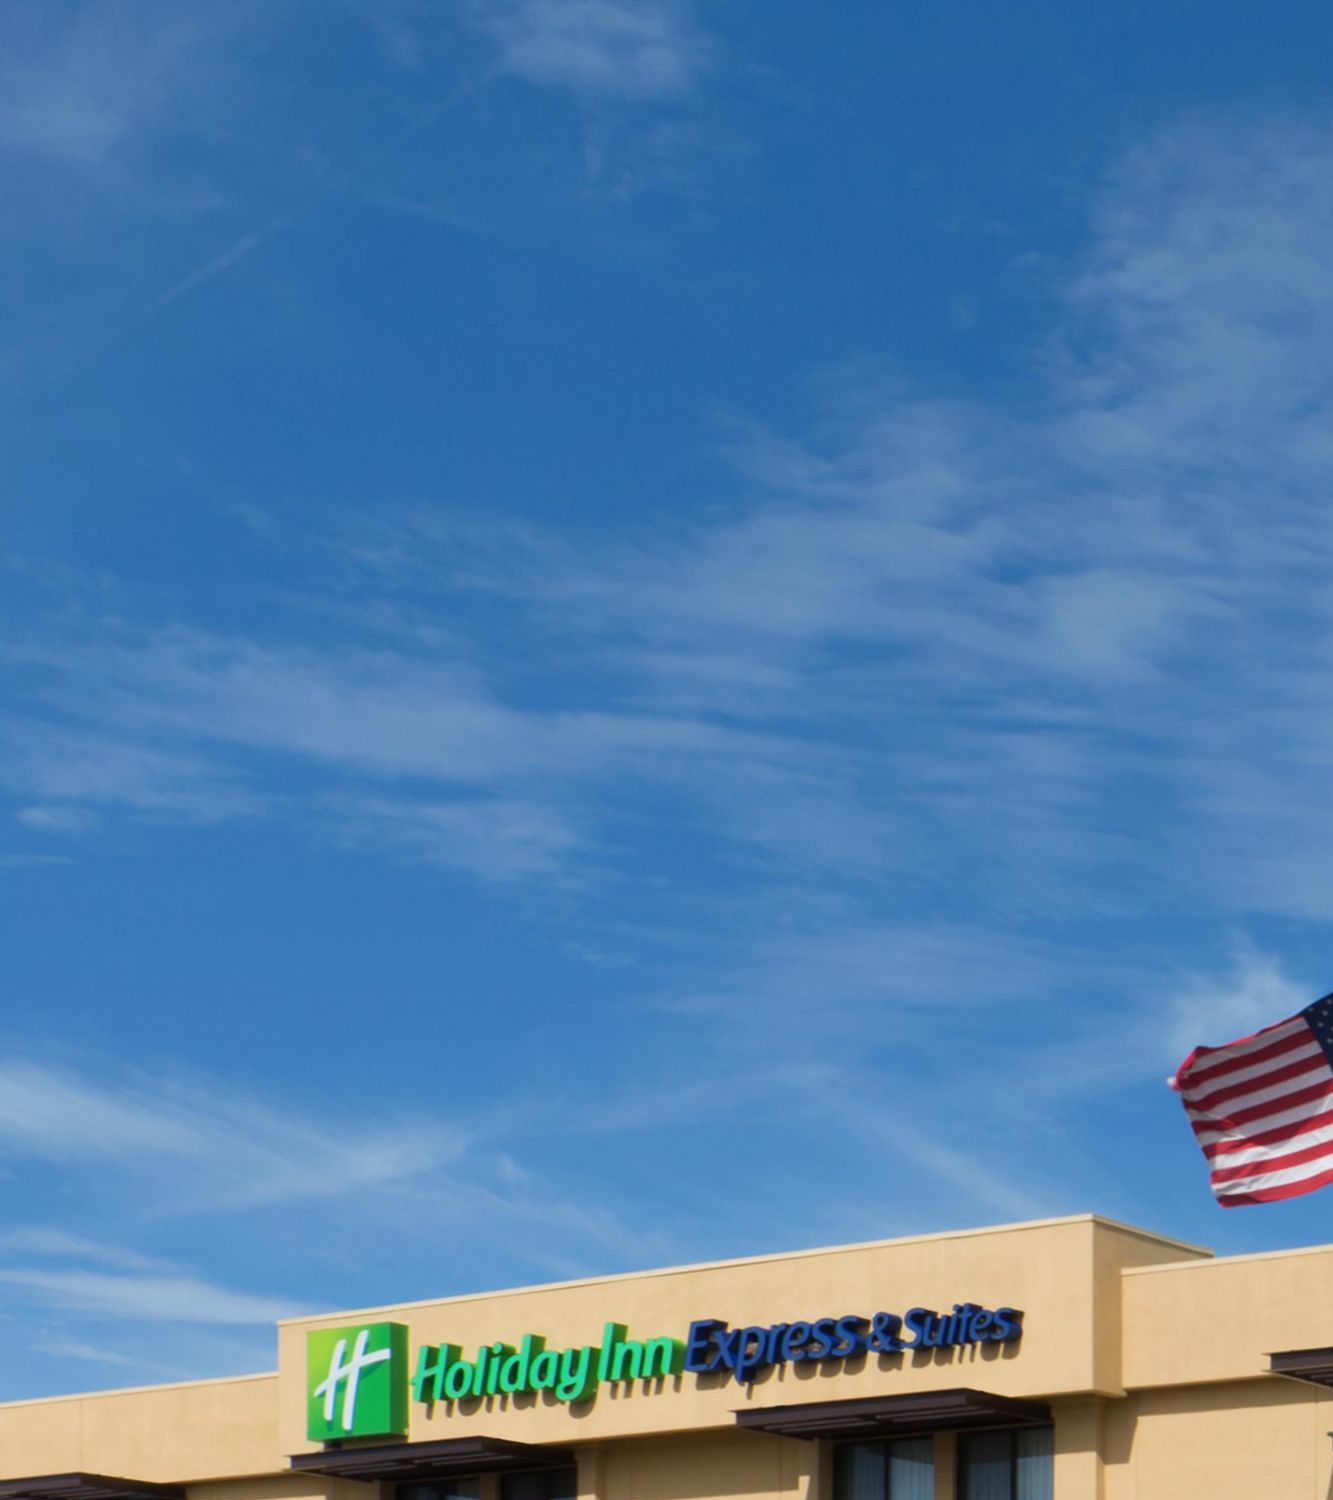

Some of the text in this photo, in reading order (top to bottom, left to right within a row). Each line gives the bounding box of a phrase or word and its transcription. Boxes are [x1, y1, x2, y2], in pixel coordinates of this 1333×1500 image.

[411, 1303, 1022, 1402] Holiday Inn Express & Suites
